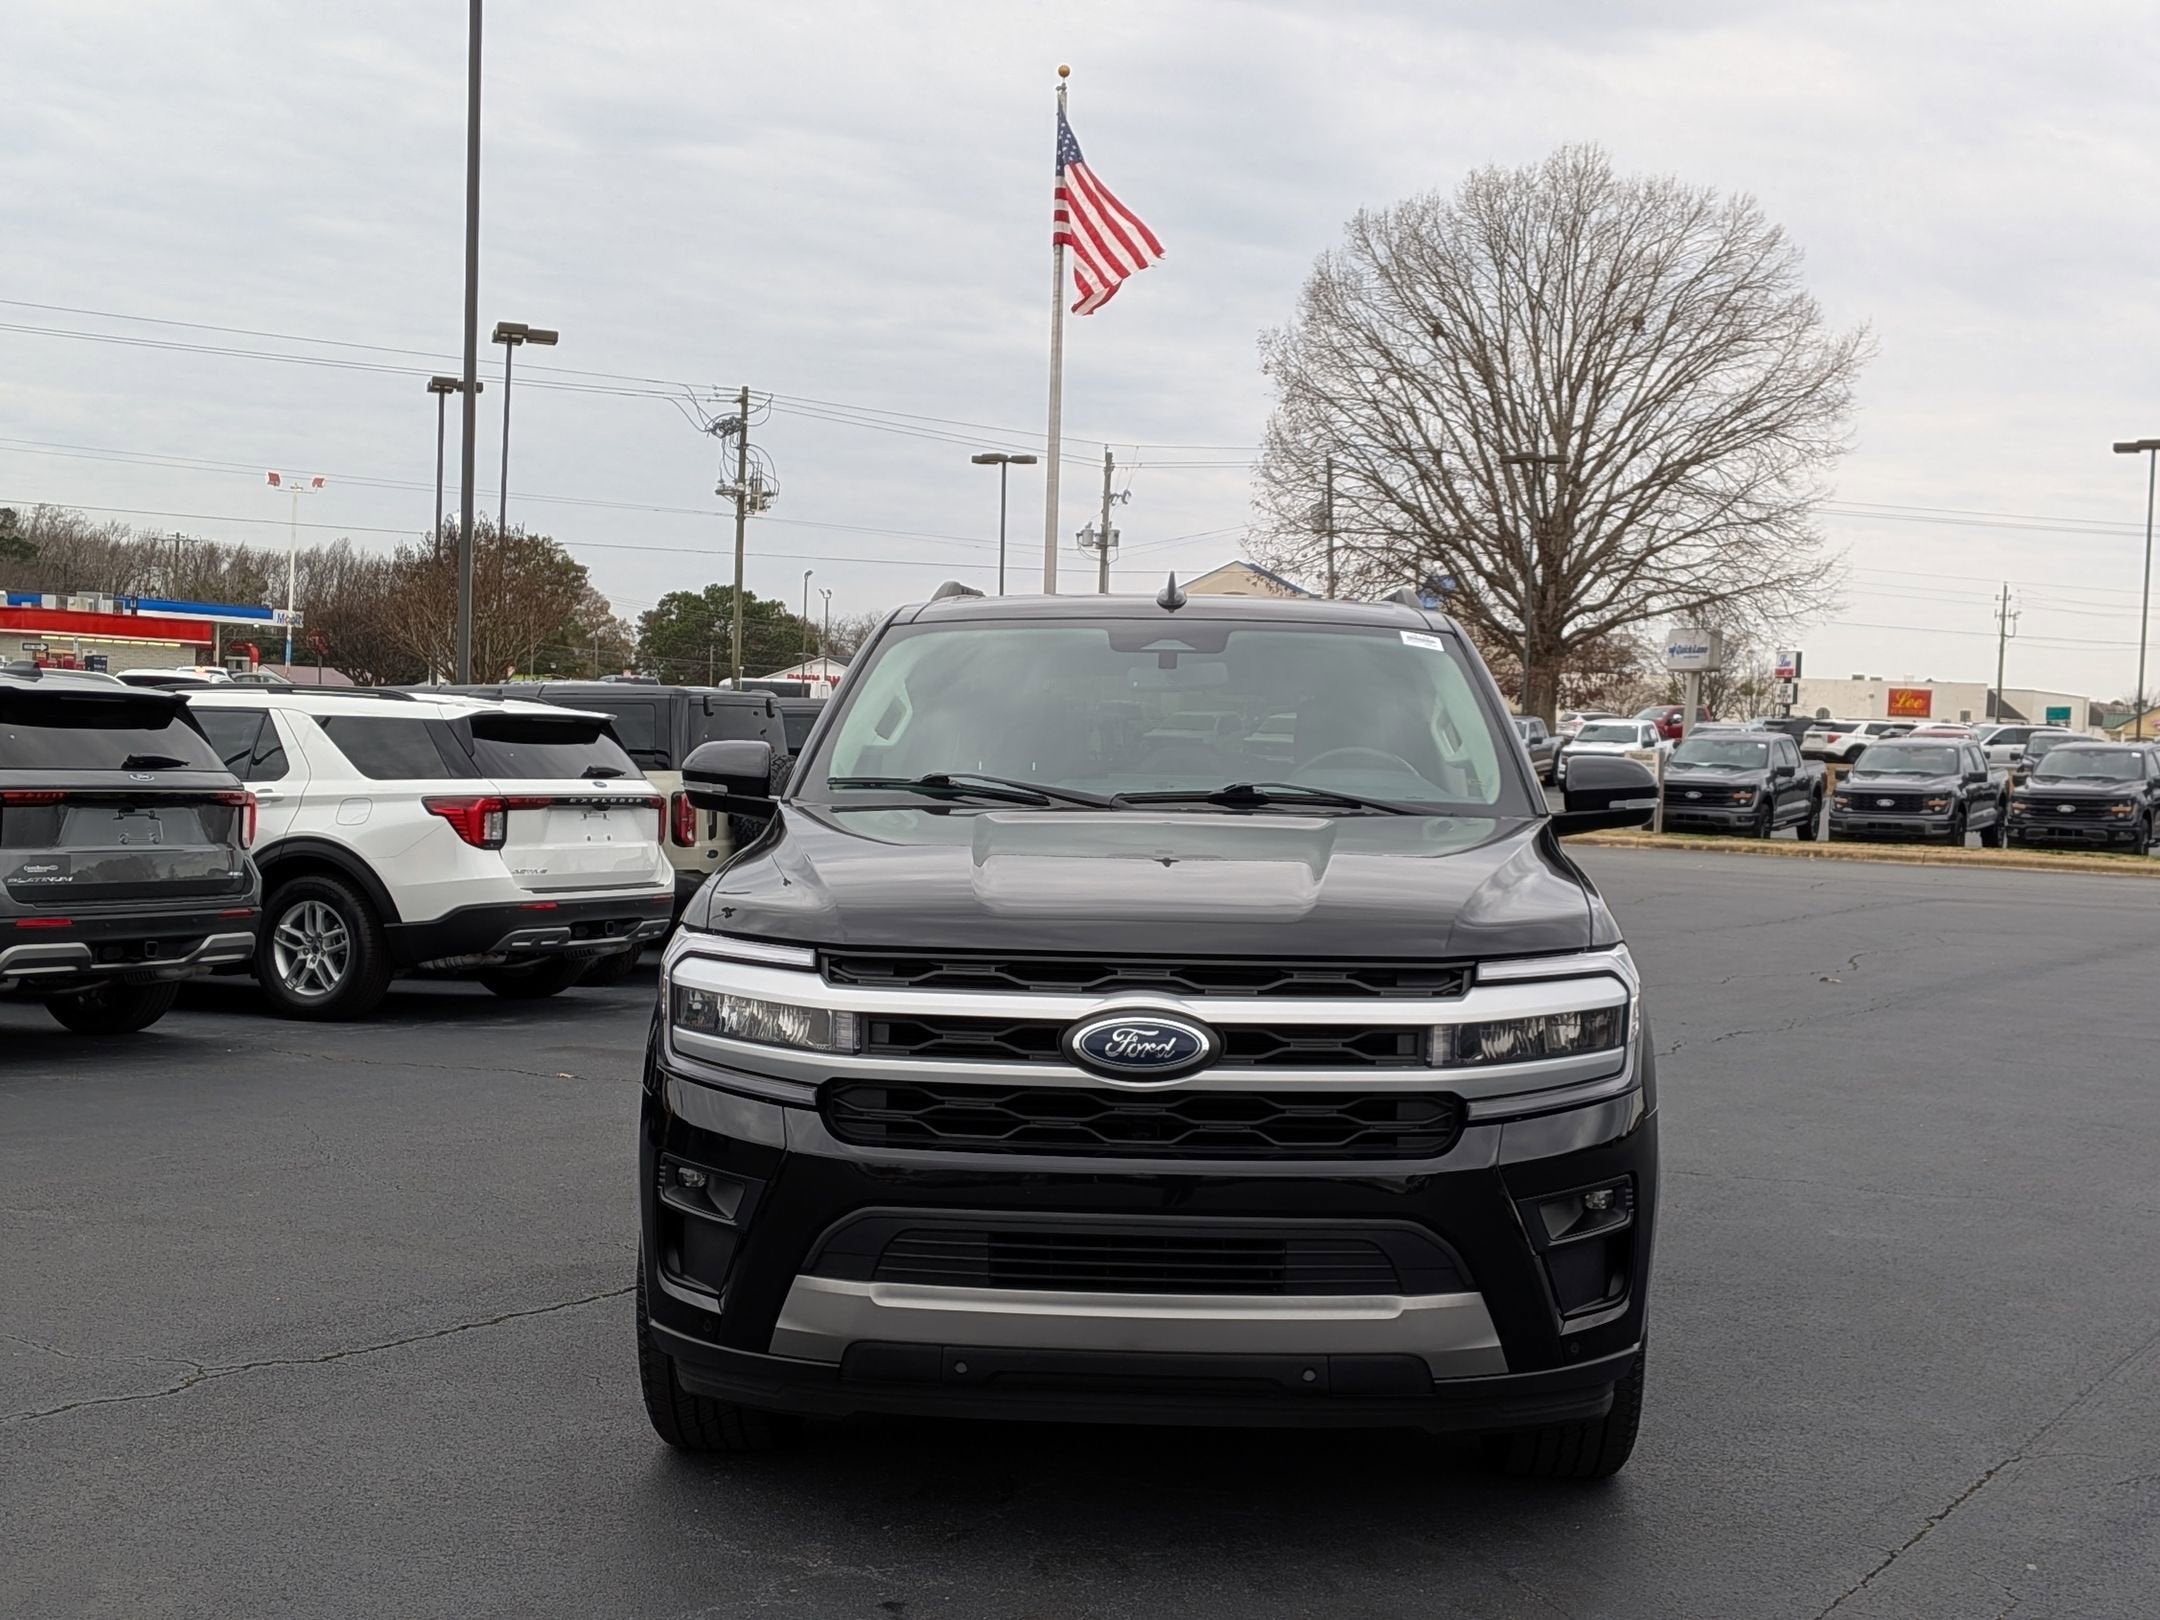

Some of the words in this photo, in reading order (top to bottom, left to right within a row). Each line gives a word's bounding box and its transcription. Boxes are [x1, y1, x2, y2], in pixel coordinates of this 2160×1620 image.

[1892, 690, 1926, 709] Lee
[7, 876, 74, 884] PLATINUM
[1105, 1028, 1176, 1059] Ford
